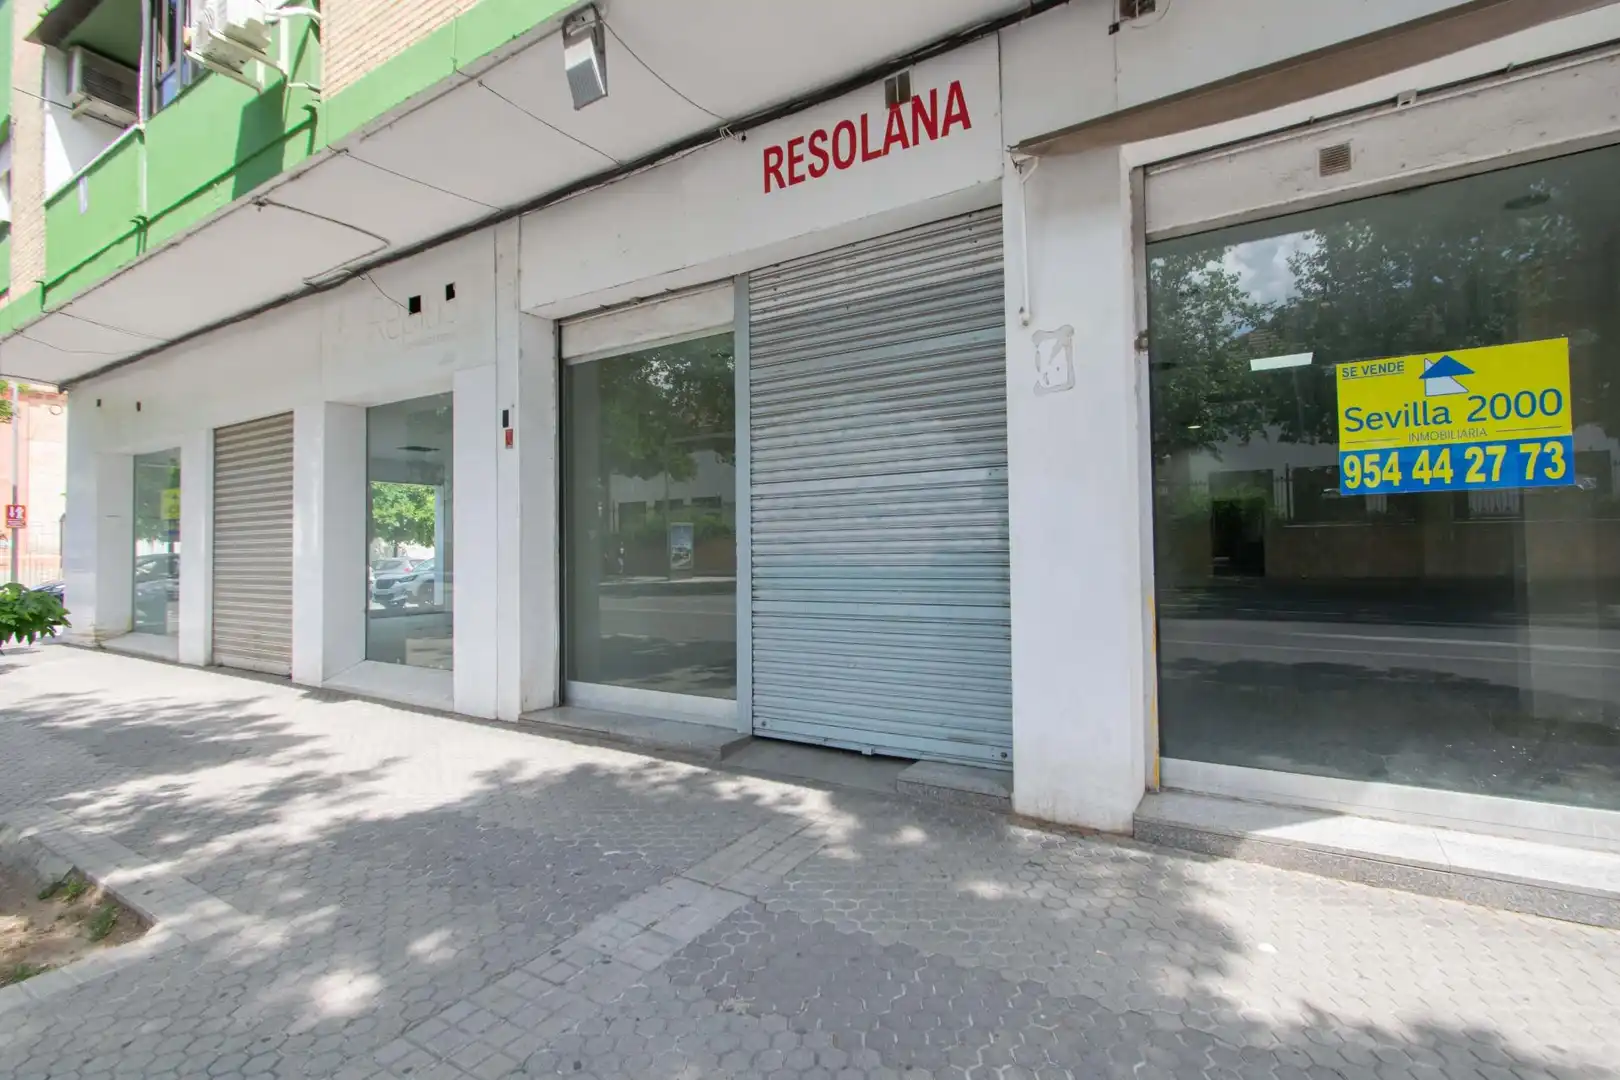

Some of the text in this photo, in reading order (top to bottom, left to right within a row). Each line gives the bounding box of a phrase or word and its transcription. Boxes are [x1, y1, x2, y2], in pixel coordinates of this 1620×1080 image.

[763, 79, 972, 194] RESOLANA
[1341, 361, 1405, 378] SE VENDE
[1344, 388, 1563, 433] Sevilla 2000
[1407, 427, 1488, 443] INMOBILIARIA
[1343, 441, 1566, 489] 954 44 27 73
